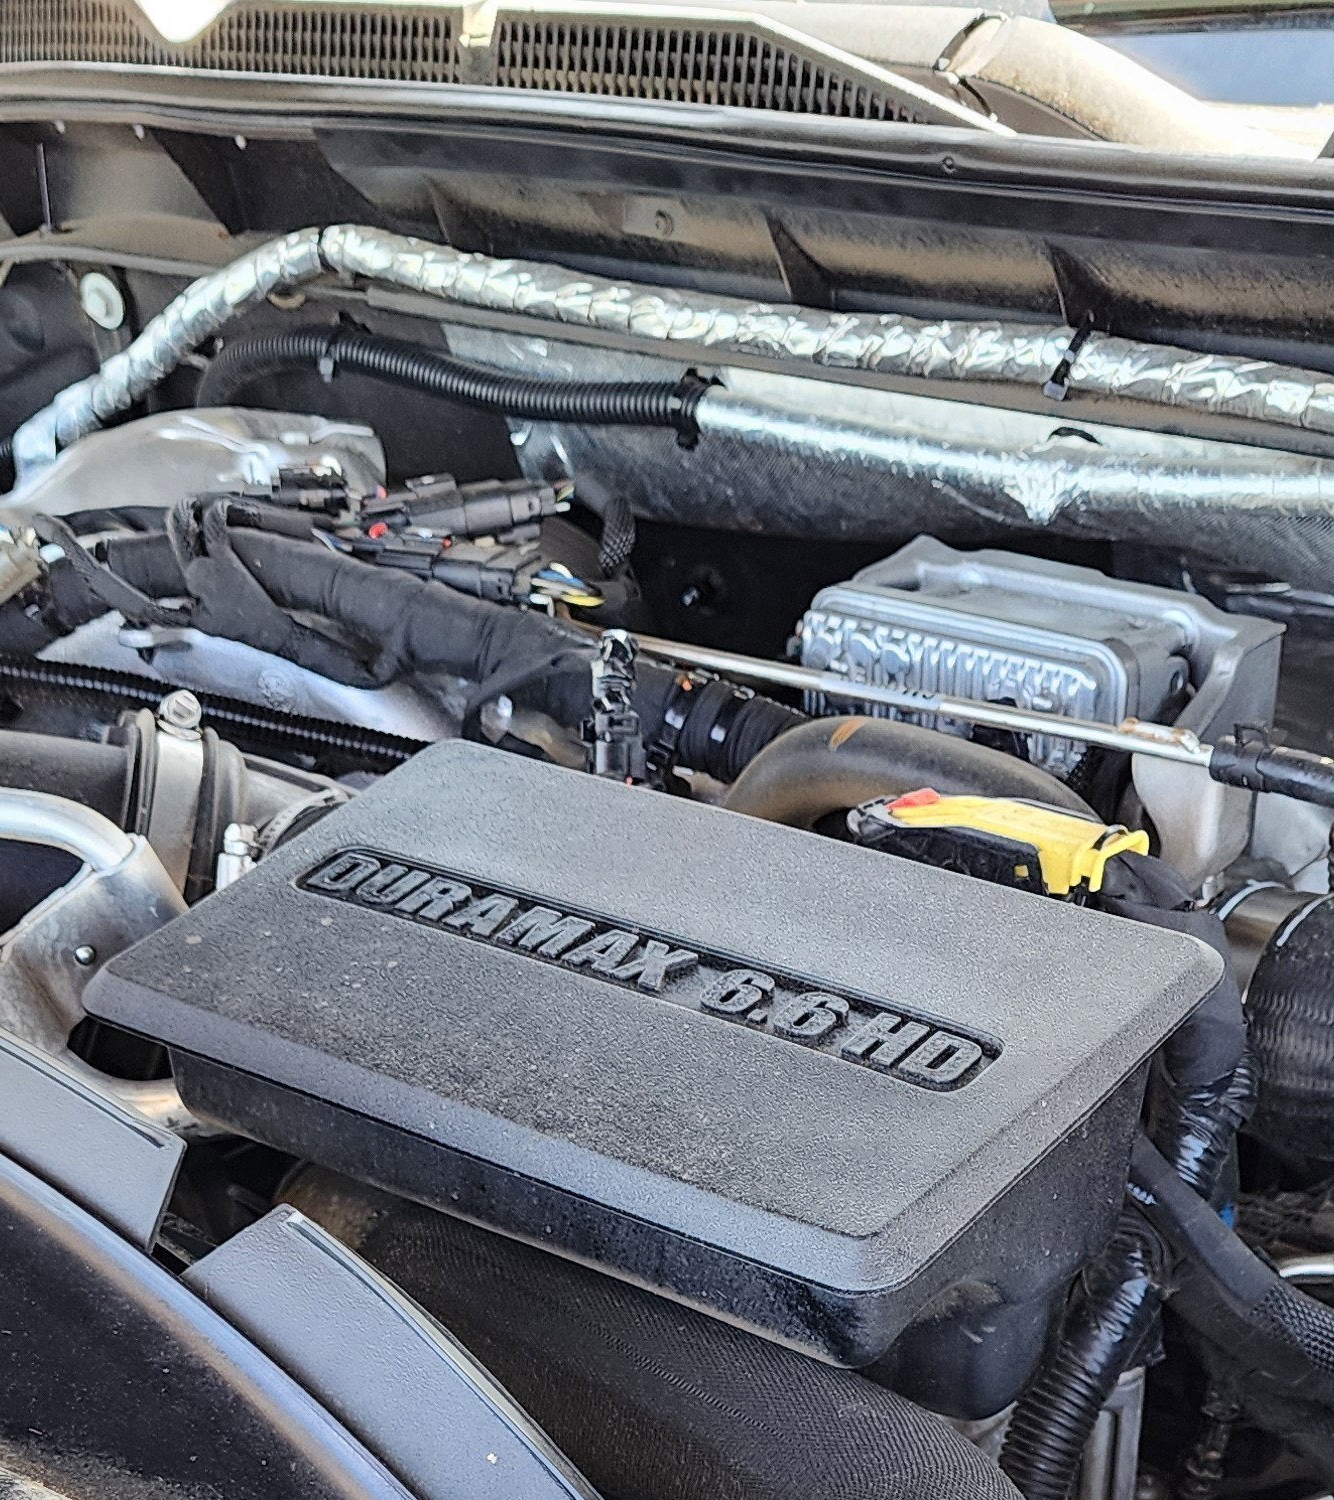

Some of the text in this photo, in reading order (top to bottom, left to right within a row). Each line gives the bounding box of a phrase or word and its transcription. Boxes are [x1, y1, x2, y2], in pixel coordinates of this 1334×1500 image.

[305, 855, 983, 1085] DURAMAX 6.6 HD
